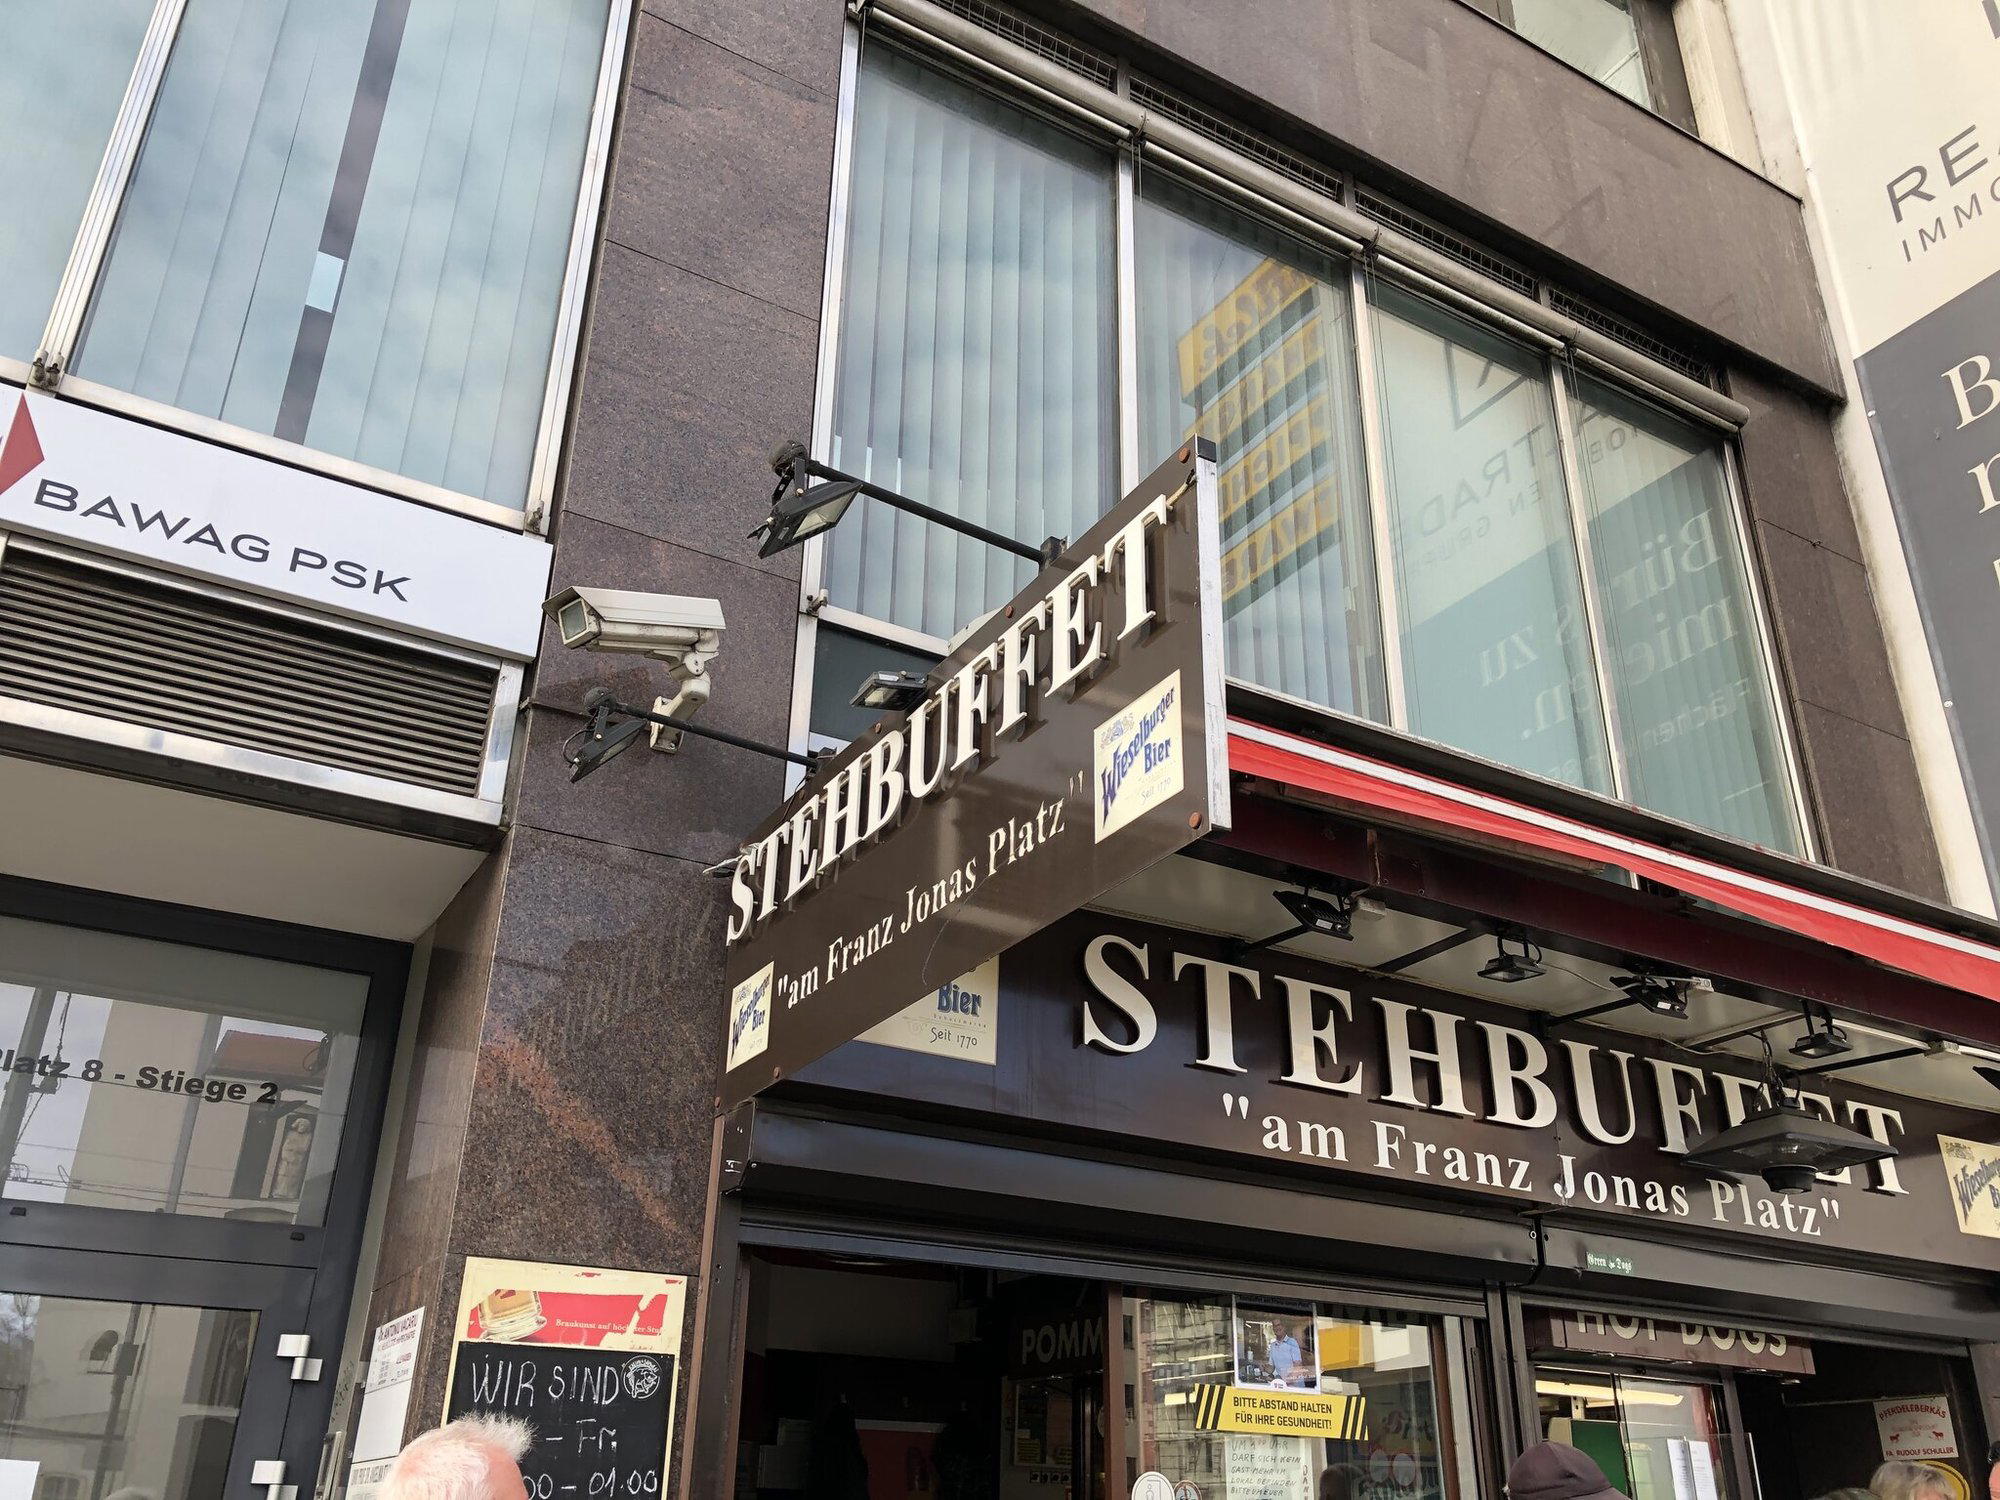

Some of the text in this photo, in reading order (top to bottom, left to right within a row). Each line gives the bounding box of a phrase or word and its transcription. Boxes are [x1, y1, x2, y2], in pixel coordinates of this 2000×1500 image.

[1886, 123, 2000, 224] RE
[34, 478, 412, 603] BAWAG PSK
[726, 493, 1169, 947] STEHBUFFET
[1101, 687, 1175, 830] Wieselburger
[1144, 737, 1171, 774] Bier
[825, 913, 894, 985] Franz
[900, 856, 977, 935] Jonas
[937, 981, 982, 1017] Bier
[930, 1026, 951, 1043] Seit
[957, 1035, 978, 1049] 1770
[0, 1047, 71, 1080] latz
[81, 1059, 103, 1082] 8
[136, 1066, 248, 1103] Stiege
[256, 1082, 279, 1105] 2
[1370, 1119, 1533, 1193] Franz
[1553, 1153, 1690, 1218] Jonas
[555, 1318, 596, 1330] Braukunst
[598, 1322, 611, 1331] auf
[612, 1323, 646, 1334] höcter
[472, 1358, 620, 1408] WIR SIND
[1233, 1396, 1332, 1414] BITTE ABSTAND HALTEN
[1235, 1411, 1332, 1430] FÜR IHRE GESUNDHEIT!
[1879, 1403, 1947, 1421] PFERDELEBERKÄS
